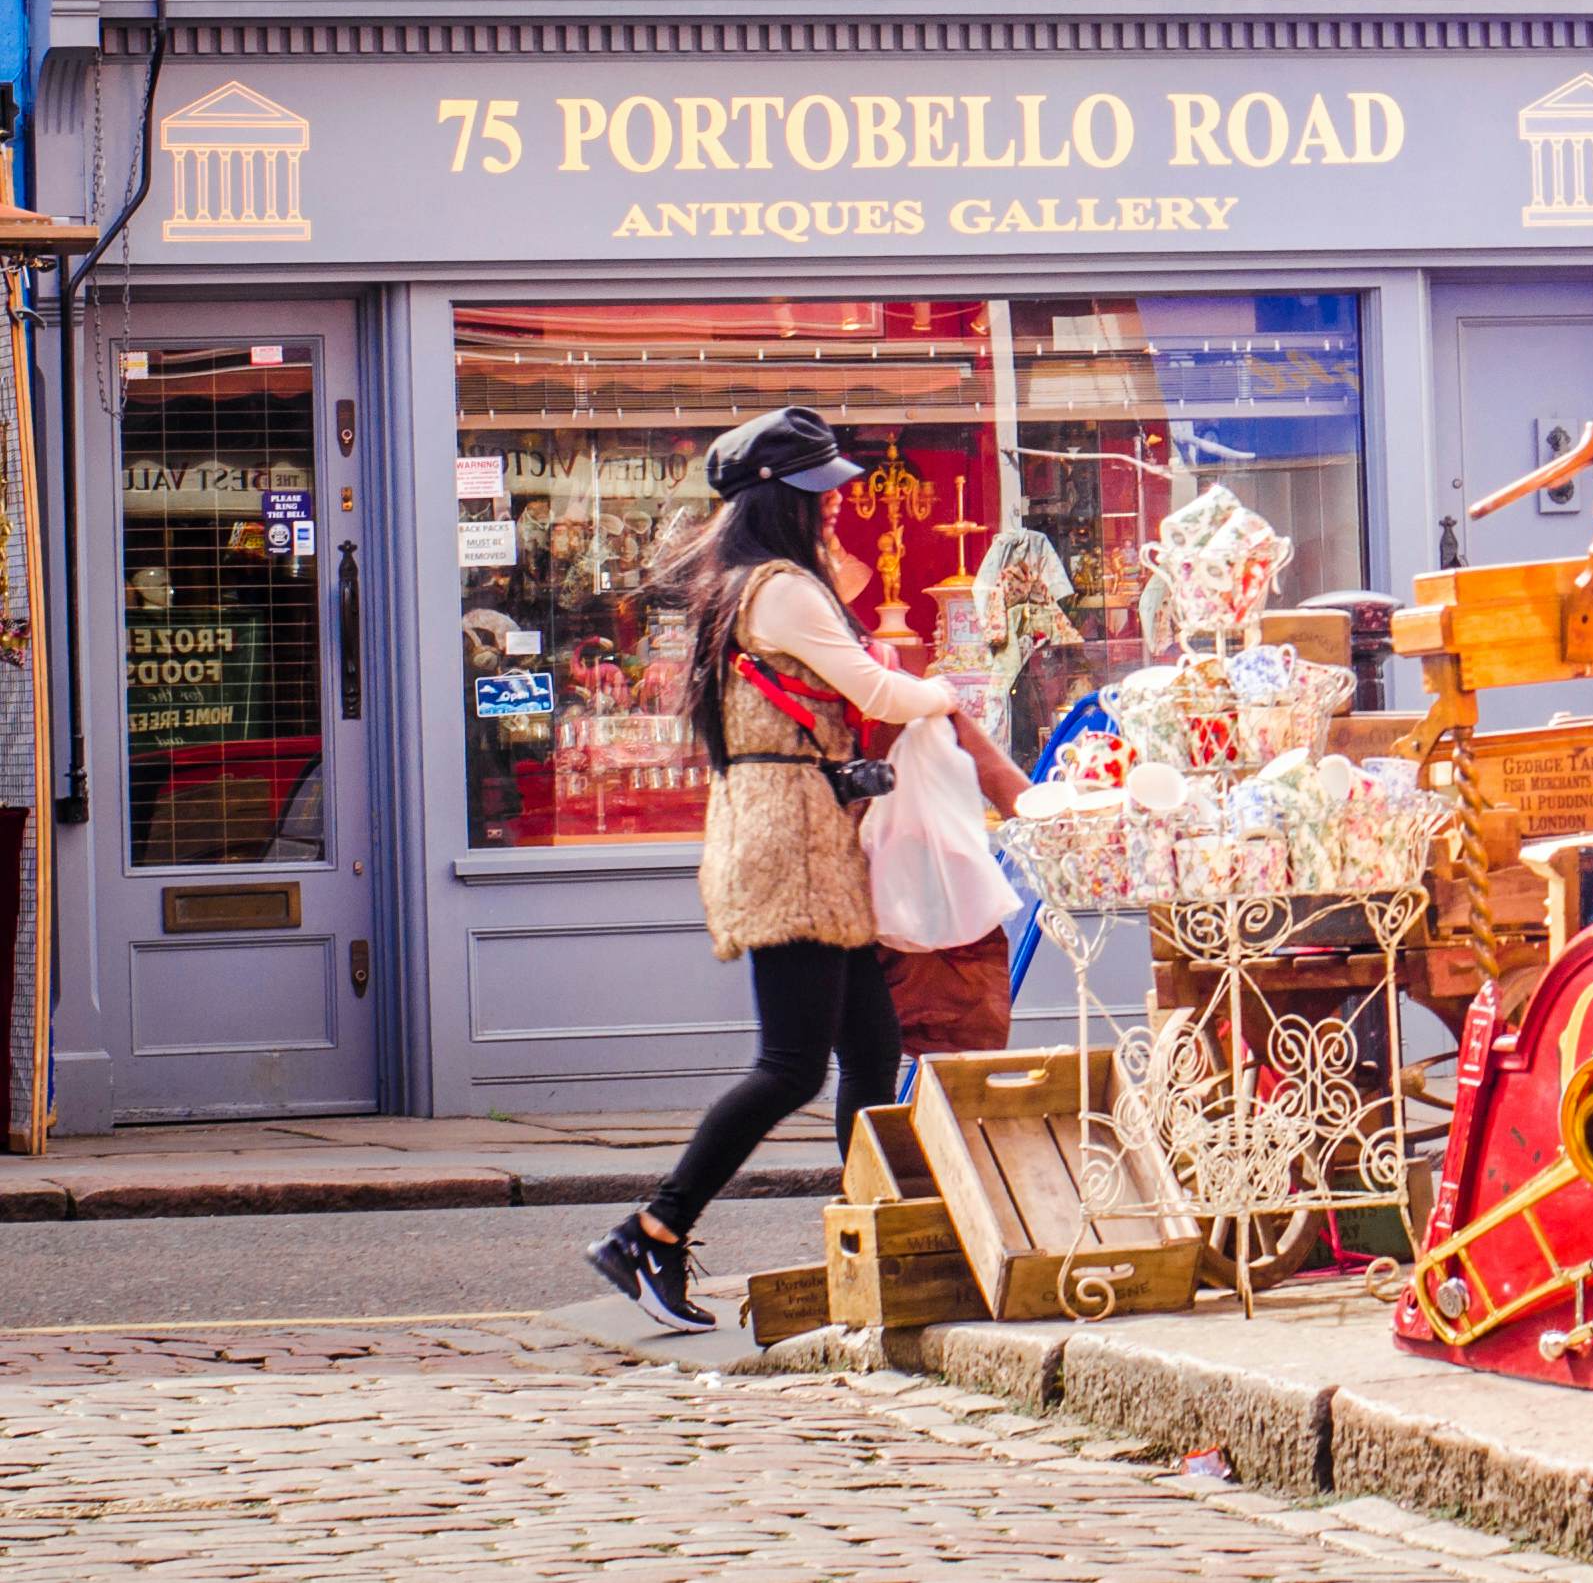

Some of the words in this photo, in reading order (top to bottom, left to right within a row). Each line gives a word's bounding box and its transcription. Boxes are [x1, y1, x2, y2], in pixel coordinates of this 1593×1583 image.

[437, 99, 523, 174] 75
[557, 91, 1136, 173] PORTOBELLO
[1166, 91, 1406, 168] ROAD
[612, 199, 925, 243] ANTIQUES
[949, 195, 1240, 236] GALLERY
[456, 460, 500, 470] WARNING
[270, 494, 303, 503] PLEASE
[275, 503, 298, 511] RING
[267, 510, 285, 519] THE
[286, 510, 308, 519] BELL
[482, 523, 510, 533] PACKS
[466, 539, 490, 549] MUST
[464, 552, 507, 562] REMOVED
[1503, 778, 1526, 793] FISH
[1530, 775, 1591, 792] MERCHANTS
[1528, 814, 1586, 831] LONDON
